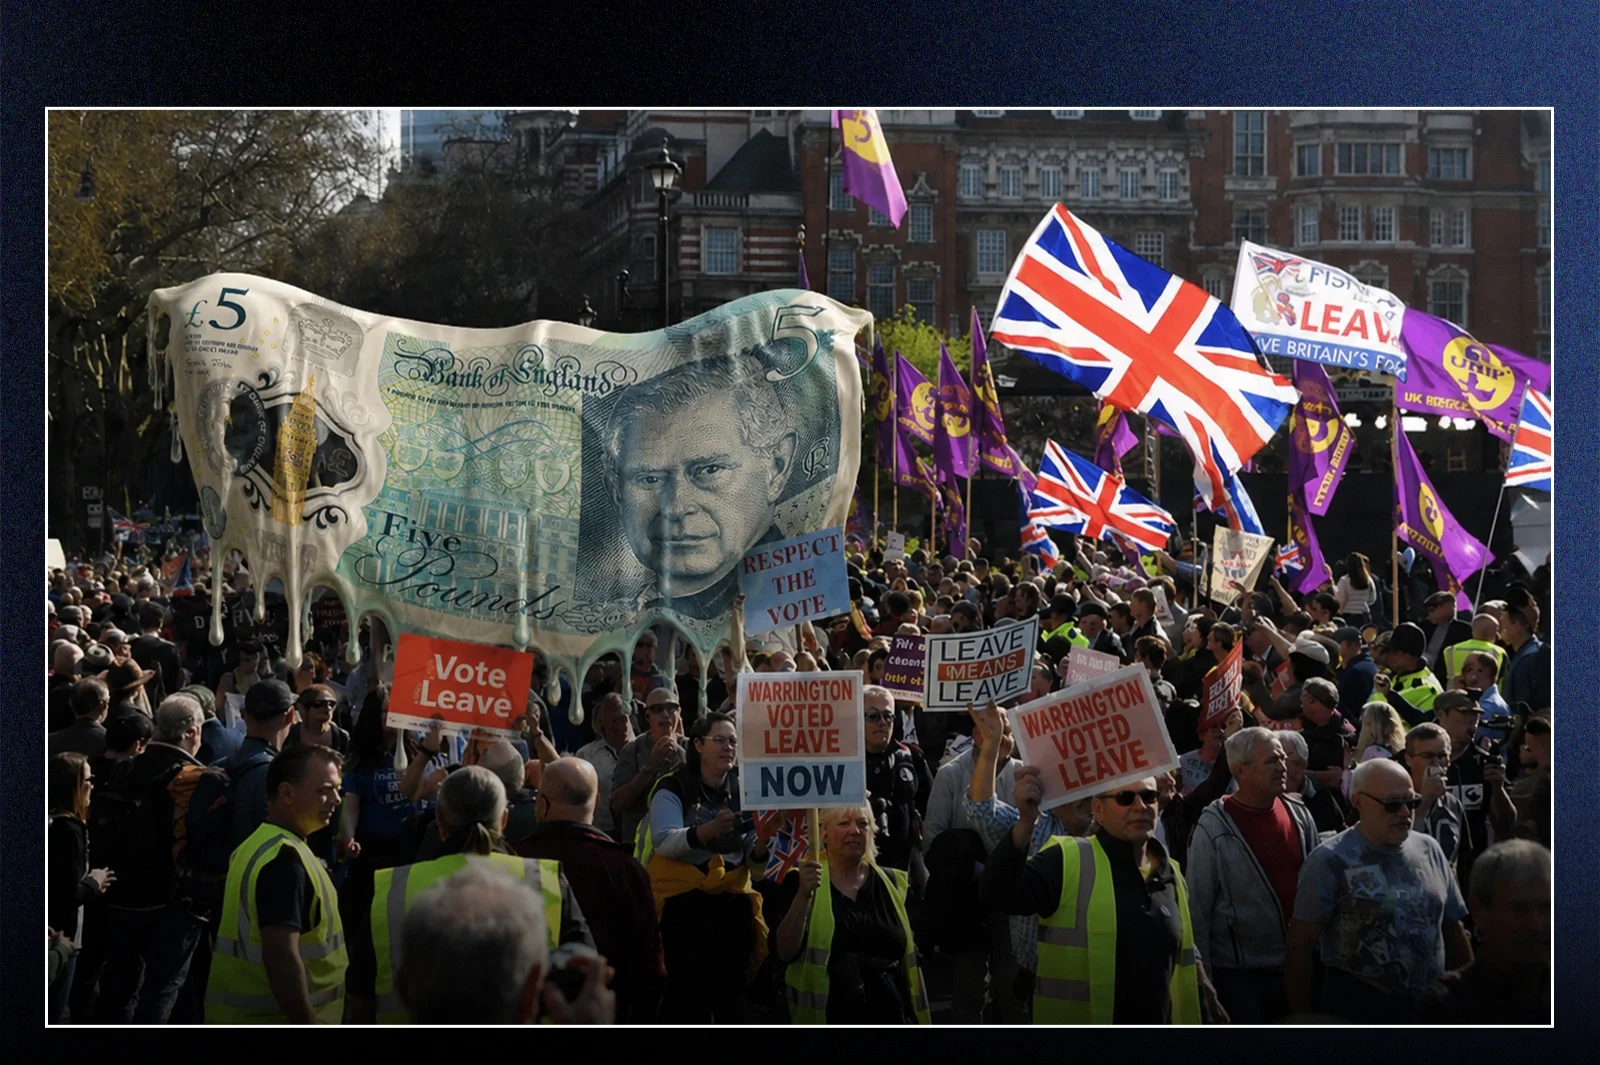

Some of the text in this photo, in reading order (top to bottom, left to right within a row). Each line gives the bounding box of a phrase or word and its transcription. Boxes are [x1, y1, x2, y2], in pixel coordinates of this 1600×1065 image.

[184, 287, 249, 330] £5
[765, 304, 826, 382] 5
[1287, 340, 1369, 367] BRITAIN'S
[394, 339, 488, 389] Bank
[512, 344, 624, 397] England
[380, 512, 461, 551] Five
[743, 534, 839, 574] RESPECT
[355, 537, 565, 620] Pounds
[772, 568, 816, 595] THE
[767, 594, 827, 625] VOTE
[940, 626, 1025, 662] LEAVE
[434, 654, 507, 688] Vote
[949, 653, 1017, 680] MEANS
[420, 680, 512, 718] Leave
[748, 680, 853, 702] WARRINGTON
[938, 669, 1024, 702] LEAVE
[767, 704, 834, 728] VOTED
[1022, 680, 1145, 739] WARRINGTON
[764, 729, 840, 754] LEAVE
[1051, 714, 1131, 760] VOTED
[761, 764, 845, 797] NOW
[1058, 740, 1149, 791] LEAVE
